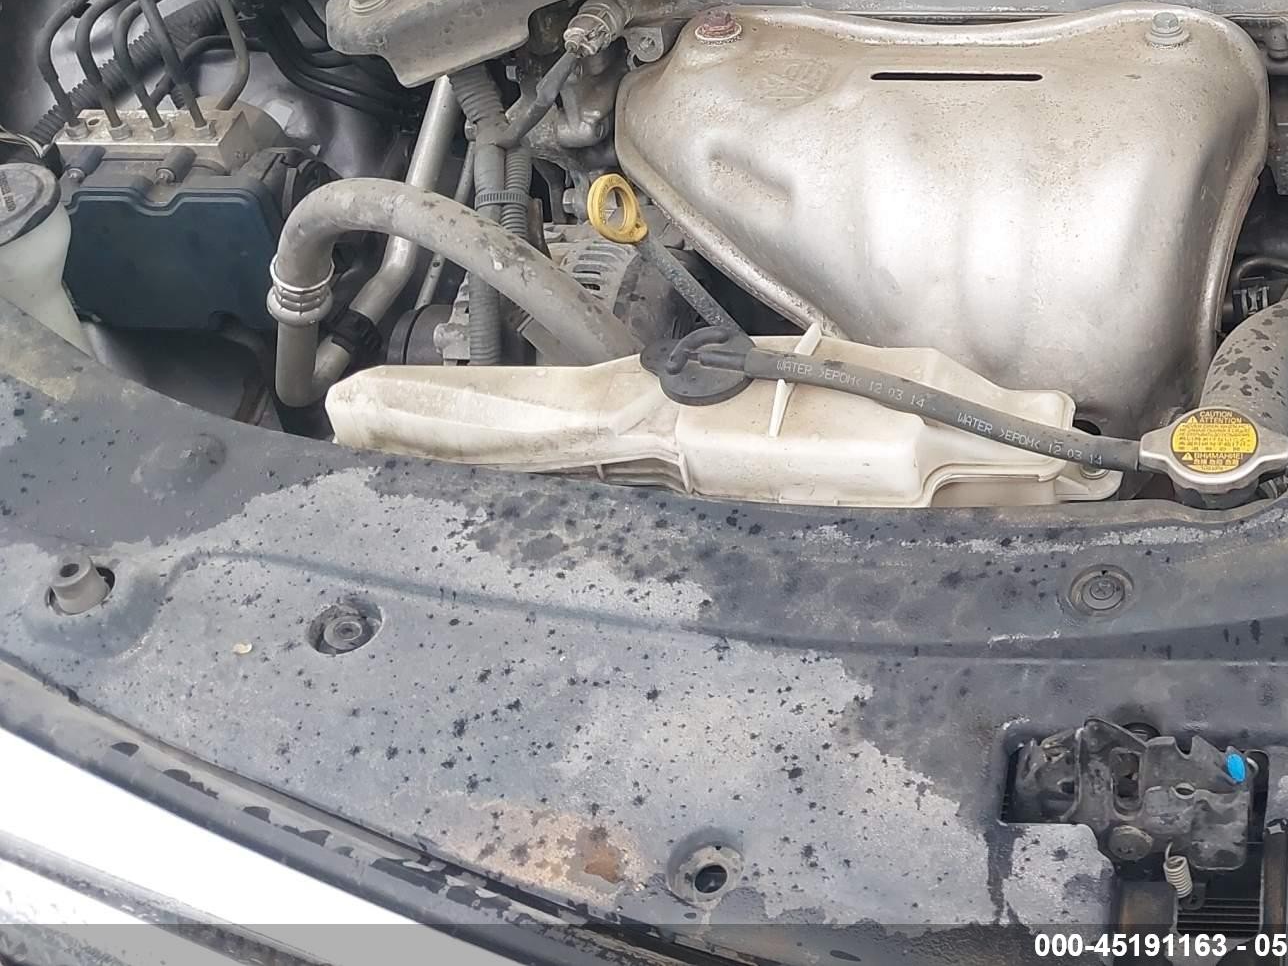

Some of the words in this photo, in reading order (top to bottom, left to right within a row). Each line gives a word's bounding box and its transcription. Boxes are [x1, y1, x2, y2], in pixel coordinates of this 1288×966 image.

[776, 360, 813, 375] WATER
[868, 380, 883, 395] 12
[888, 387, 904, 401] 03
[911, 394, 926, 408] 14
[957, 412, 993, 434] WATER
[1048, 442, 1063, 456] 12
[1066, 448, 1083, 460] 03
